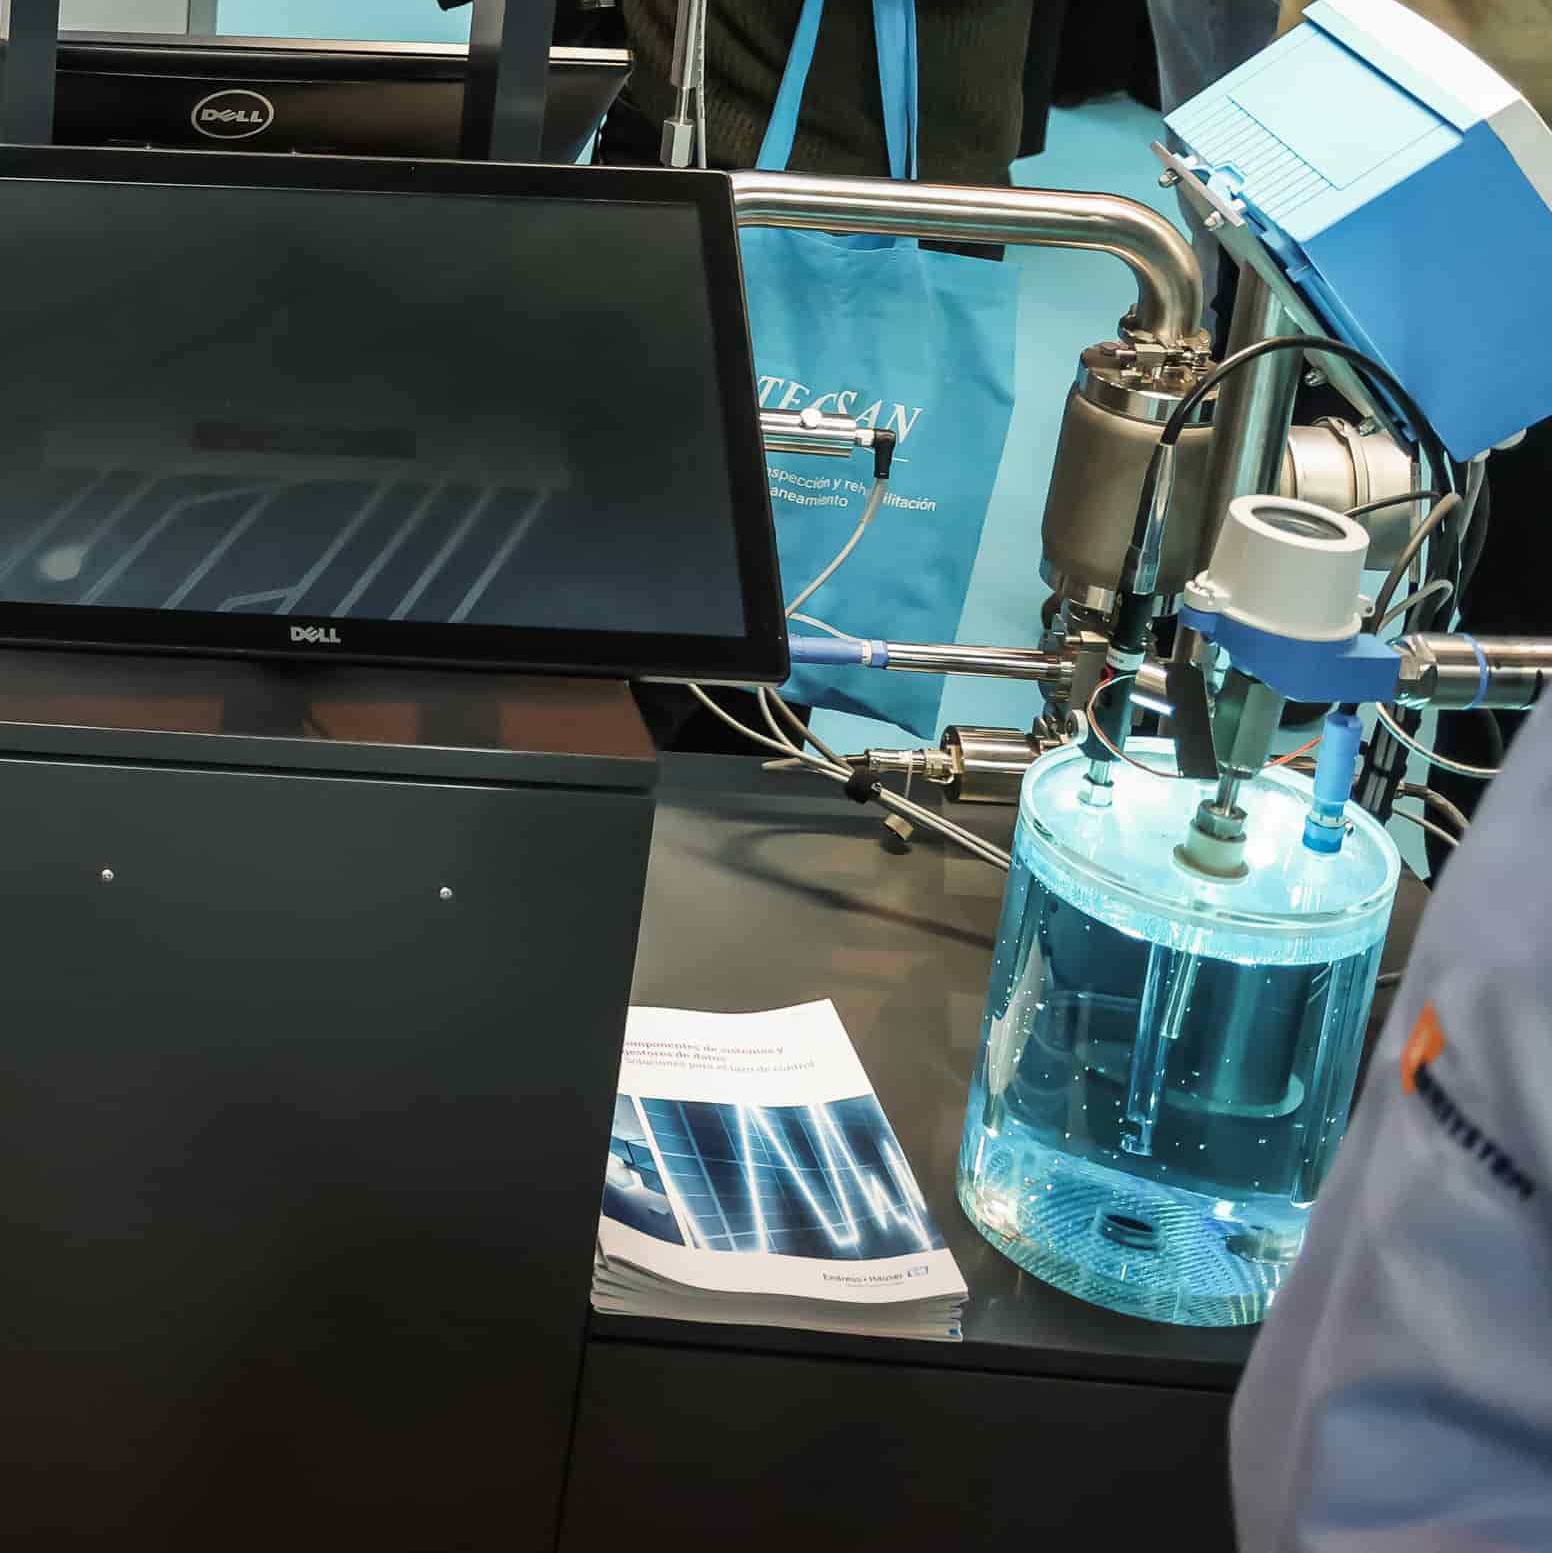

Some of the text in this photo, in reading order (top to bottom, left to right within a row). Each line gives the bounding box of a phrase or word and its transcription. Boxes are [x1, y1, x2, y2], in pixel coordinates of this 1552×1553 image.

[200, 108, 264, 123] DELL
[769, 485, 849, 508] aneamiento
[831, 477, 842, 491] y
[845, 480, 937, 512] rehilitación
[290, 626, 342, 643] DELL
